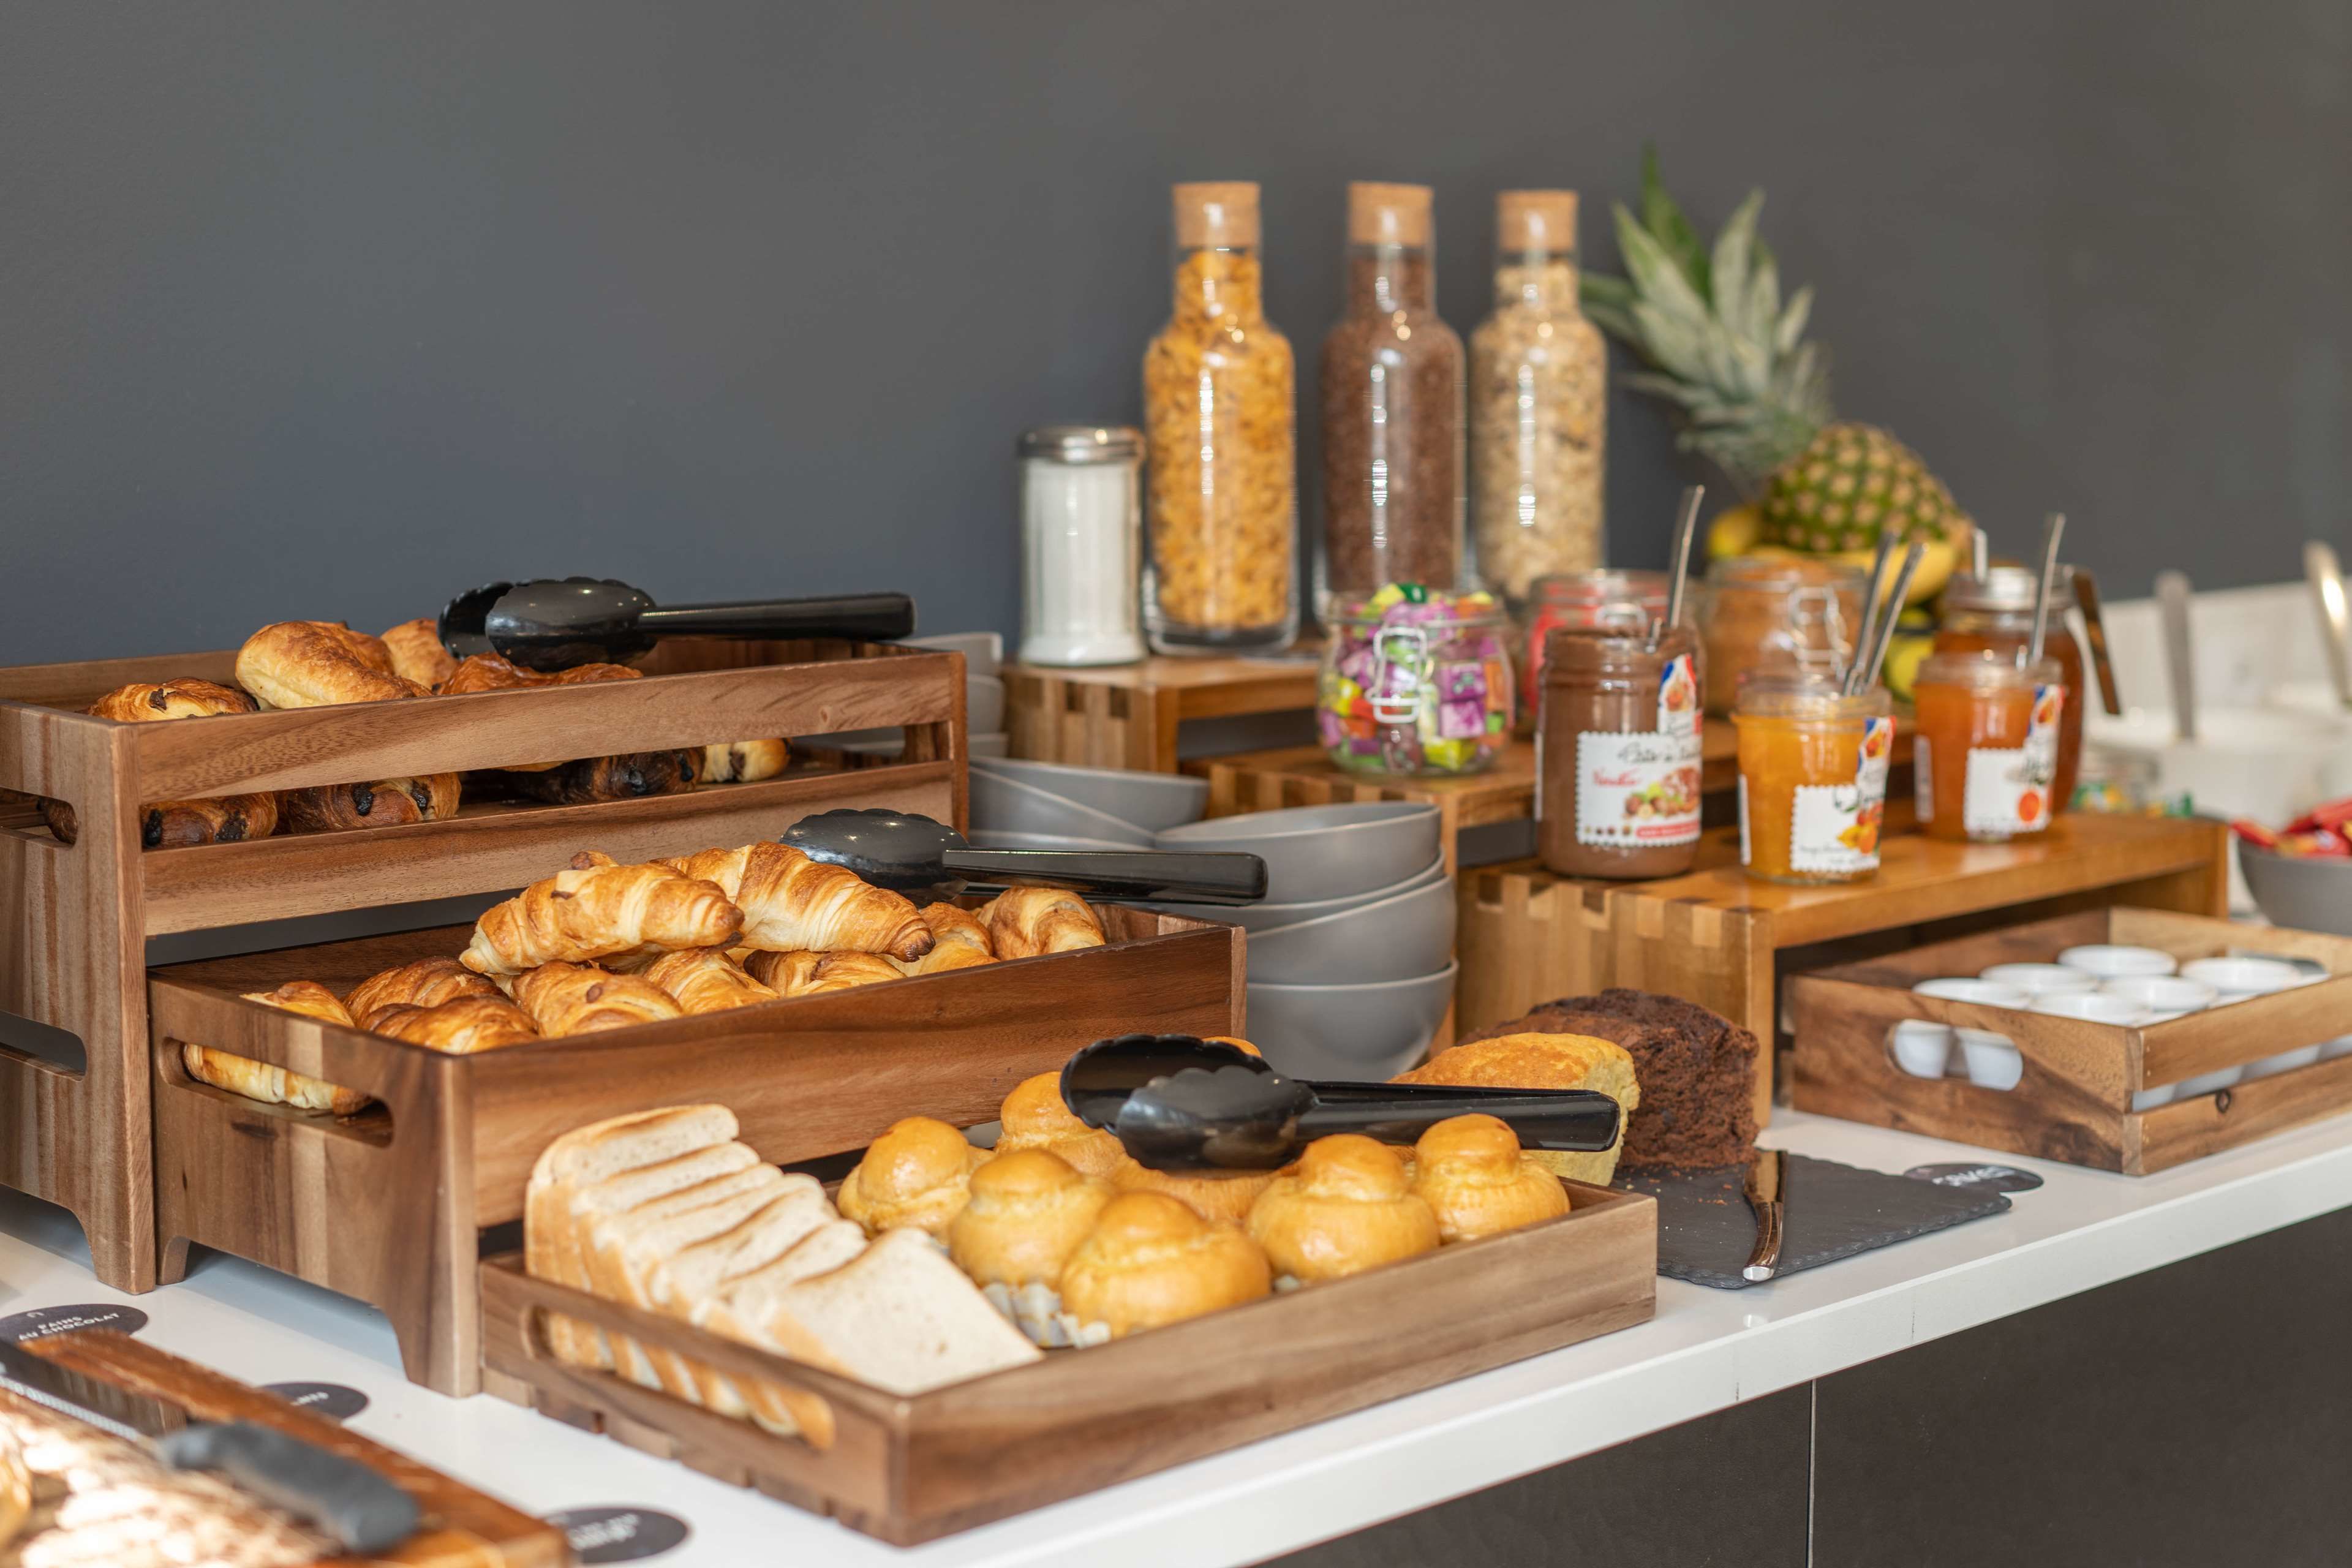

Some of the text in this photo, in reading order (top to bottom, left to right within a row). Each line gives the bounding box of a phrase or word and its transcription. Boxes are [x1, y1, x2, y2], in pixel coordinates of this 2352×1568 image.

[18, 1313, 120, 1341] AU CHOCOLAT
[37, 1316, 82, 1330] PAINS
